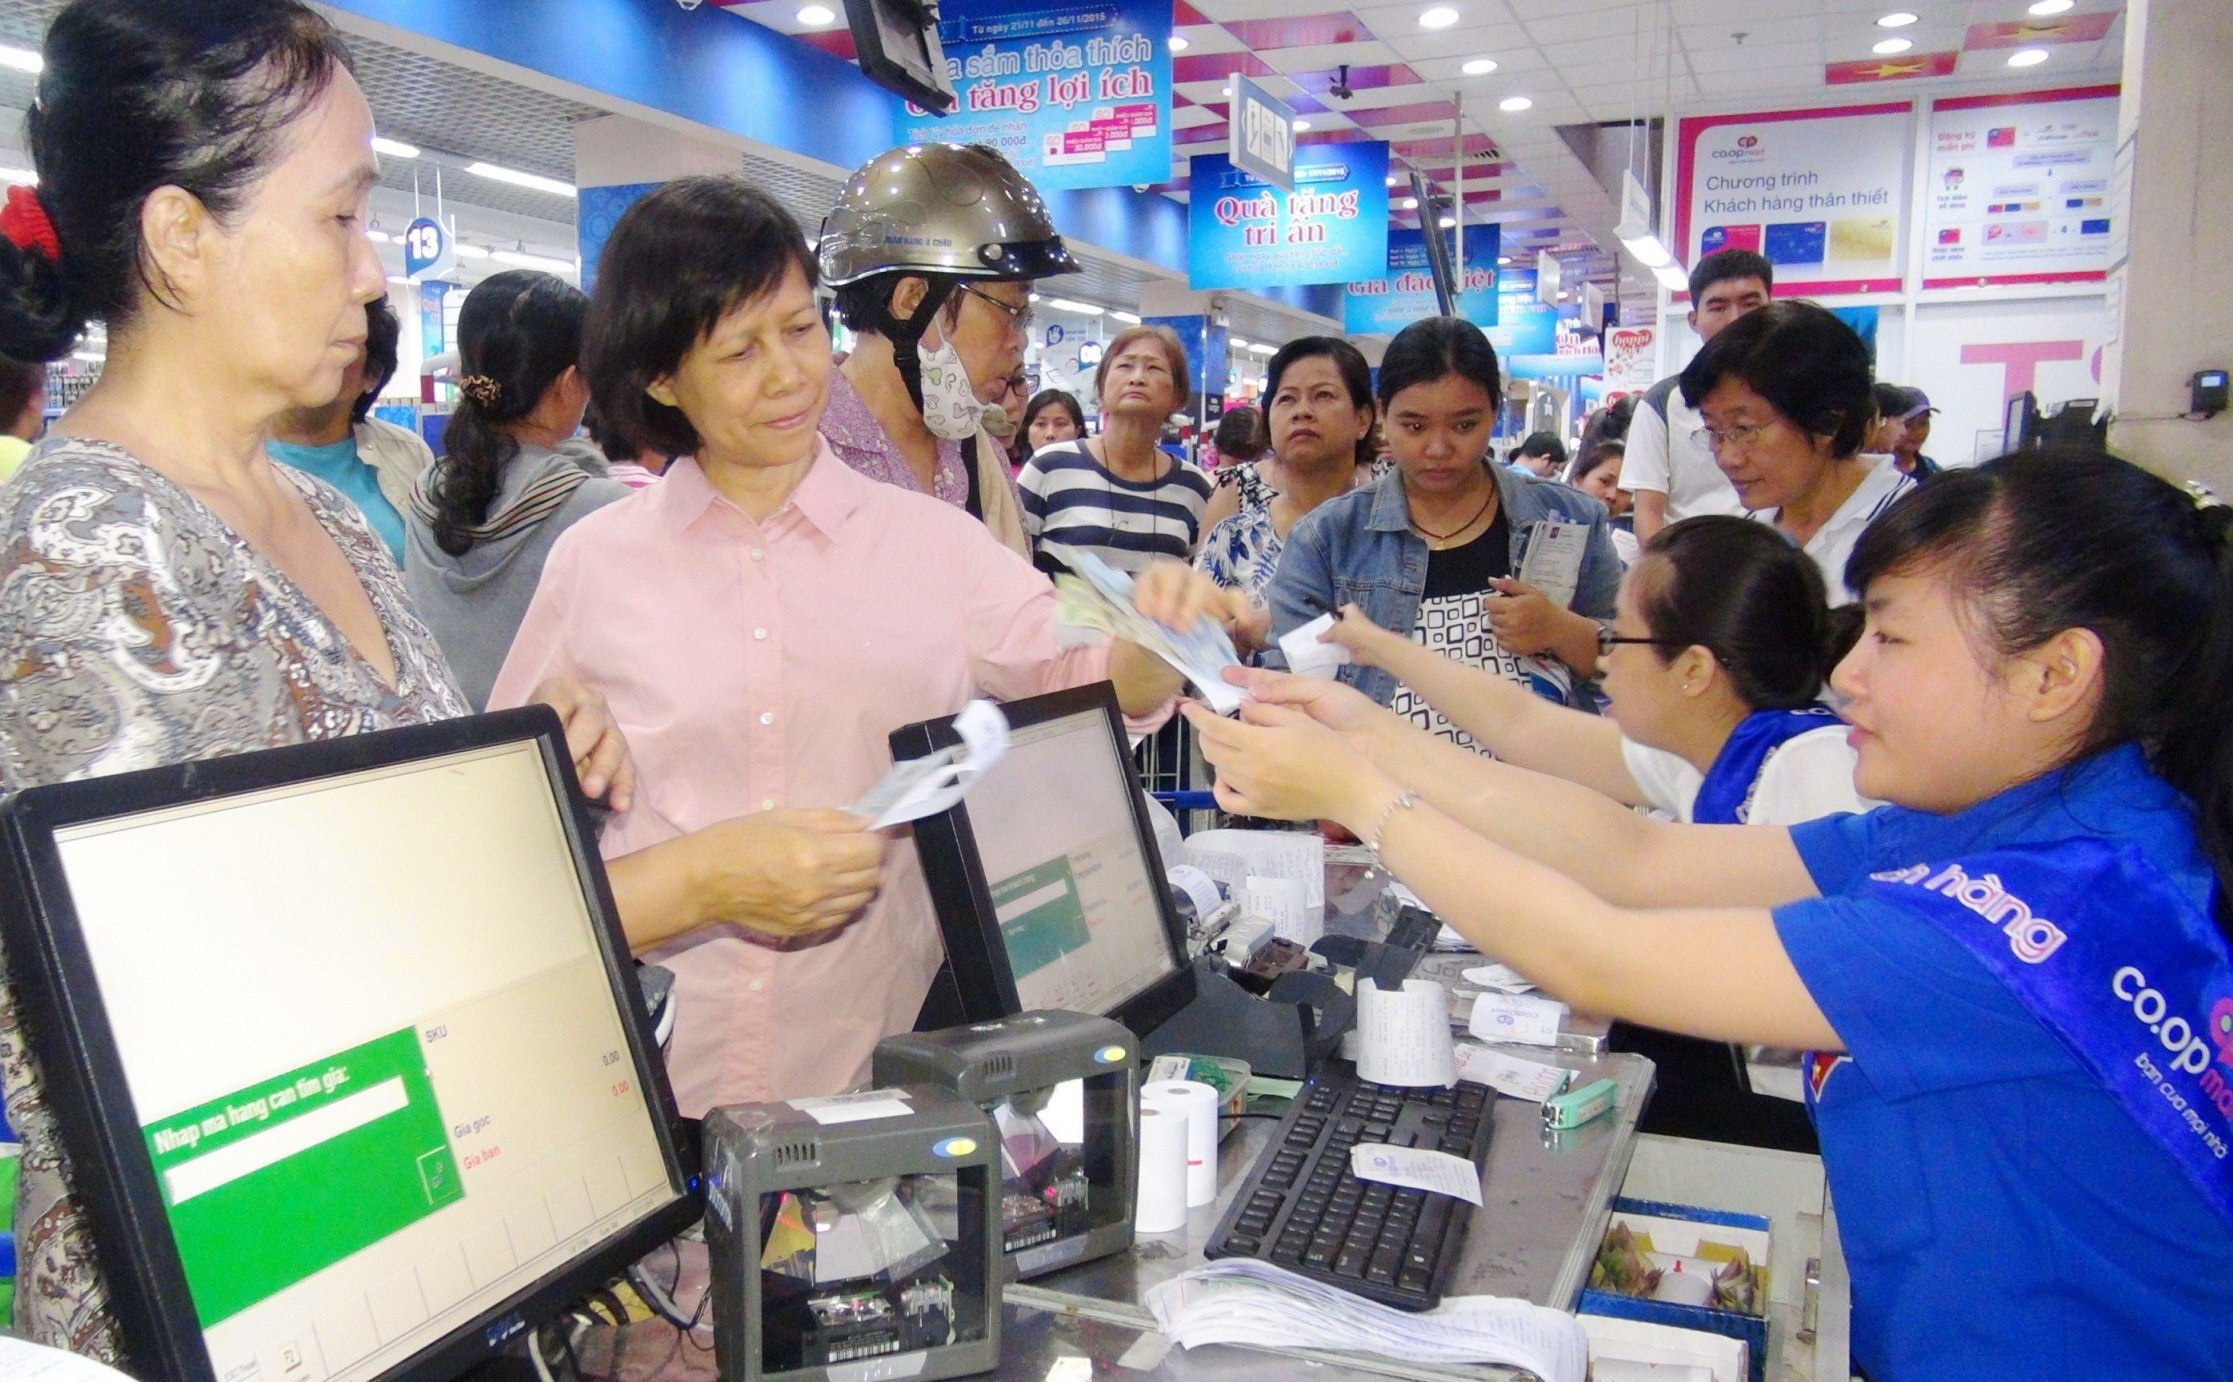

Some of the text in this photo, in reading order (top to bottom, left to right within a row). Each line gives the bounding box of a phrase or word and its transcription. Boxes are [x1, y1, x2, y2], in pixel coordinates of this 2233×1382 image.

[967, 45, 1020, 77] sắm
[1025, 41, 1082, 72] thỏa
[1088, 35, 1150, 65] thích
[969, 77, 1037, 110] tăng
[1049, 72, 1089, 108] lợi
[1101, 70, 1151, 97] ích
[1706, 170, 1819, 191] Chương trình
[1216, 188, 1359, 225] Quà tặng
[1704, 187, 1889, 214] Khách hàng thân thiết
[408, 226, 440, 259] 13
[1245, 218, 1325, 245] tri ân
[1464, 267, 1496, 292] iệt
[1926, 864, 2067, 963] hàng
[425, 1024, 448, 1043] SKU
[602, 1050, 621, 1067] 0.00
[611, 1079, 630, 1098] 0.00
[153, 1123, 201, 1155] Nhap
[201, 1114, 229, 1137] ma
[226, 1098, 269, 1126] hang
[269, 1087, 298, 1110] can
[453, 1114, 492, 1139] Gia goc
[462, 1144, 501, 1171] Gia ban
